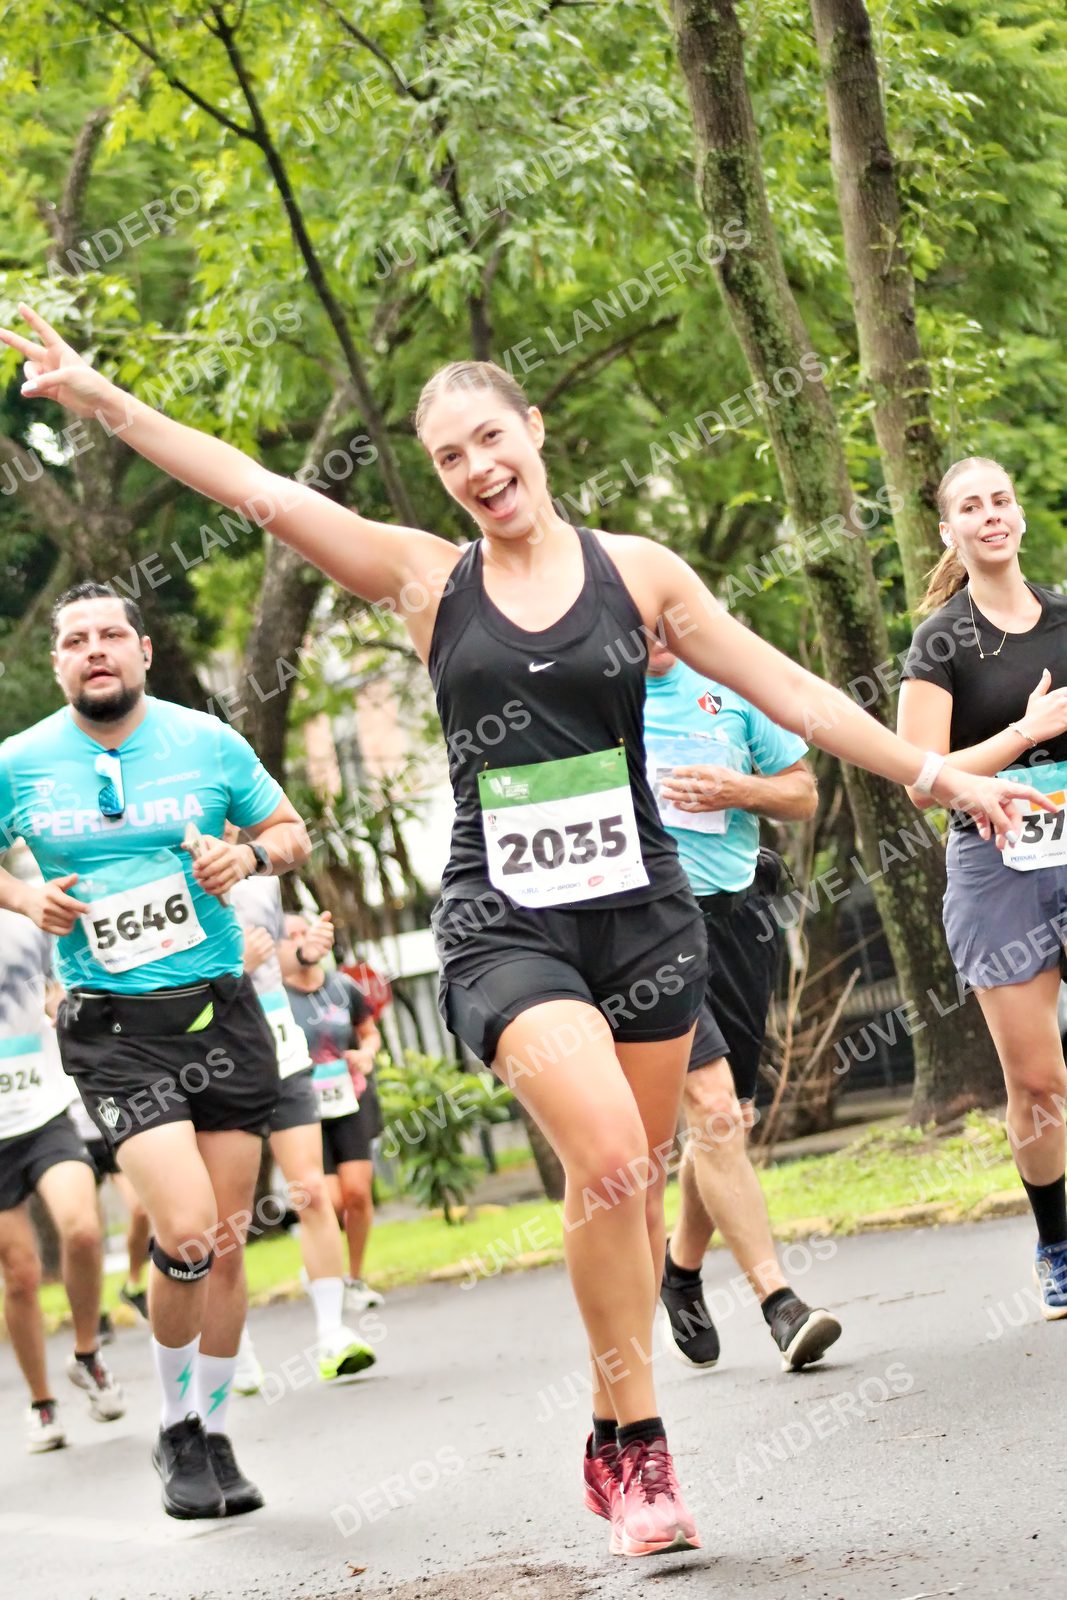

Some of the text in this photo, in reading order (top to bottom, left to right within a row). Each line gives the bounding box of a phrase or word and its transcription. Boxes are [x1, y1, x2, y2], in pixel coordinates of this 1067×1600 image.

[31, 794, 204, 837] PERDURA
[1021, 808, 1066, 844] 37
[497, 814, 627, 876] 2035
[93, 893, 190, 950] 5646
